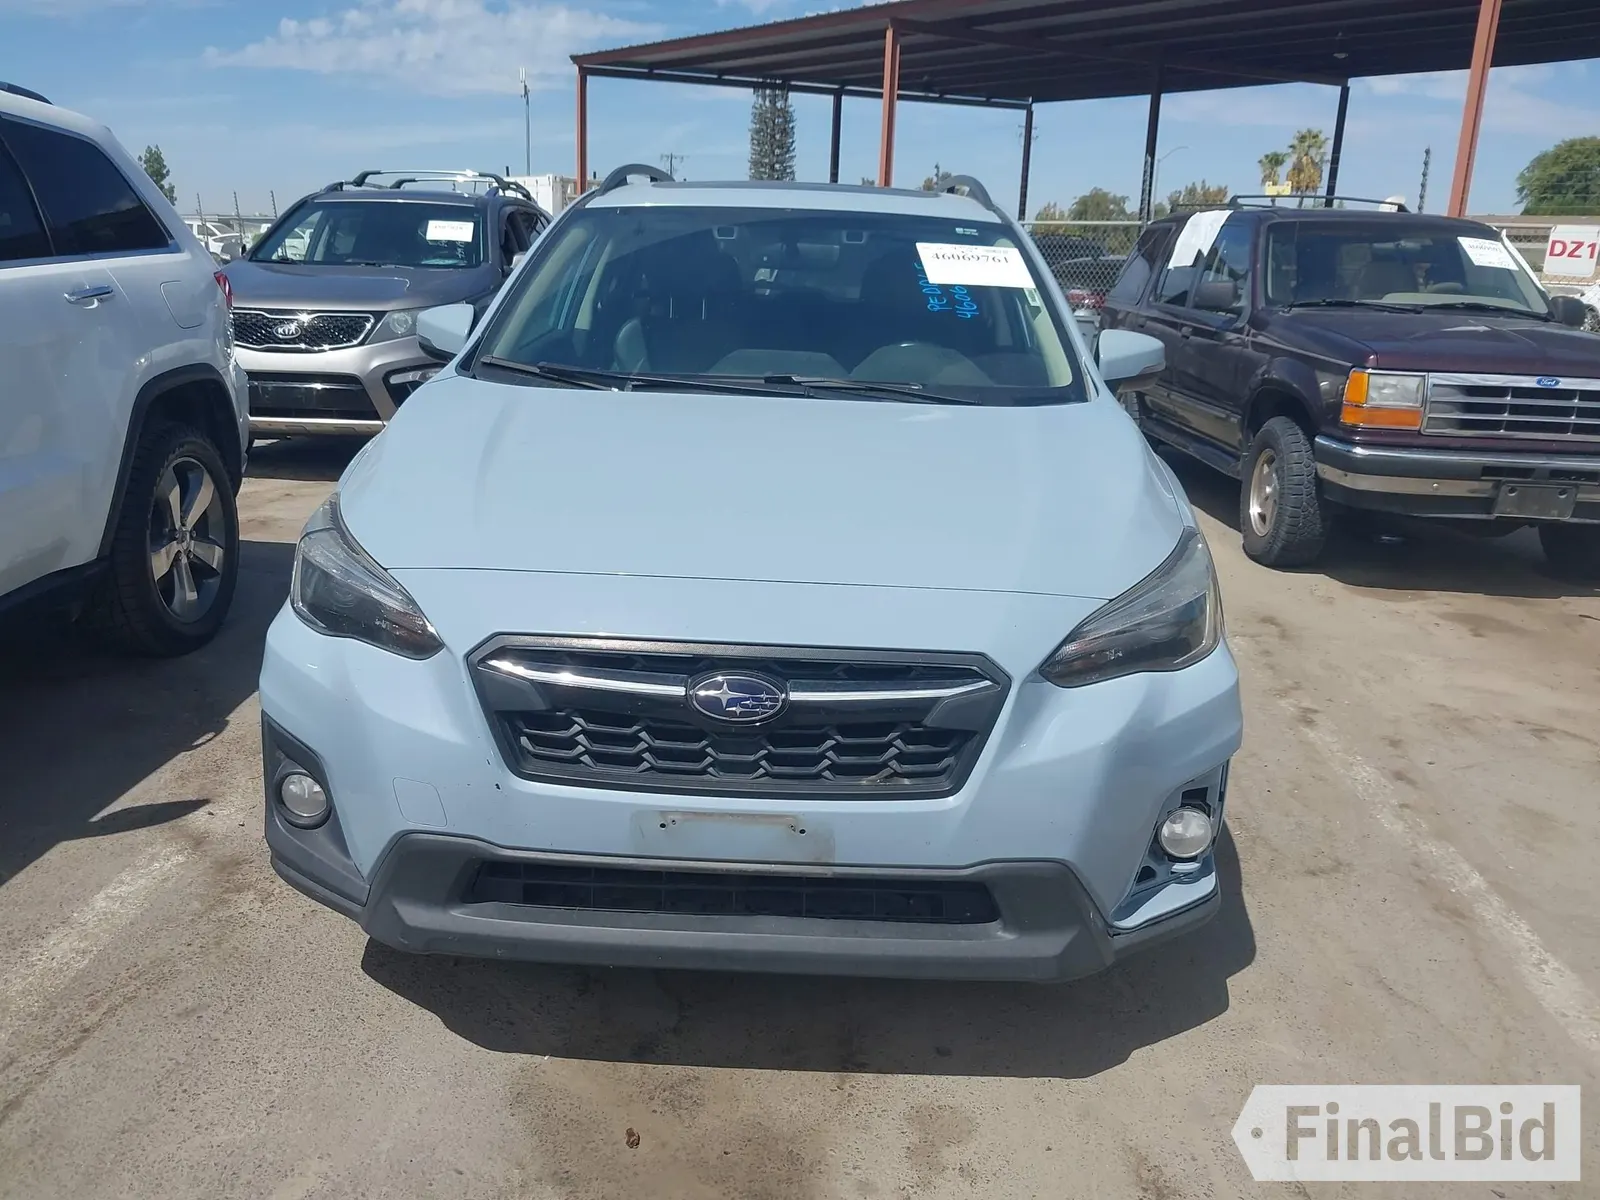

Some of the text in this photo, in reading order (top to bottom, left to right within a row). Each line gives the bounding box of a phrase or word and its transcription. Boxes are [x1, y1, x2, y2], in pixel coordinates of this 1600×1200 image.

[1548, 239, 1597, 260] DZ1
[931, 251, 1010, 264] 46069761
[278, 326, 296, 335] KIA
